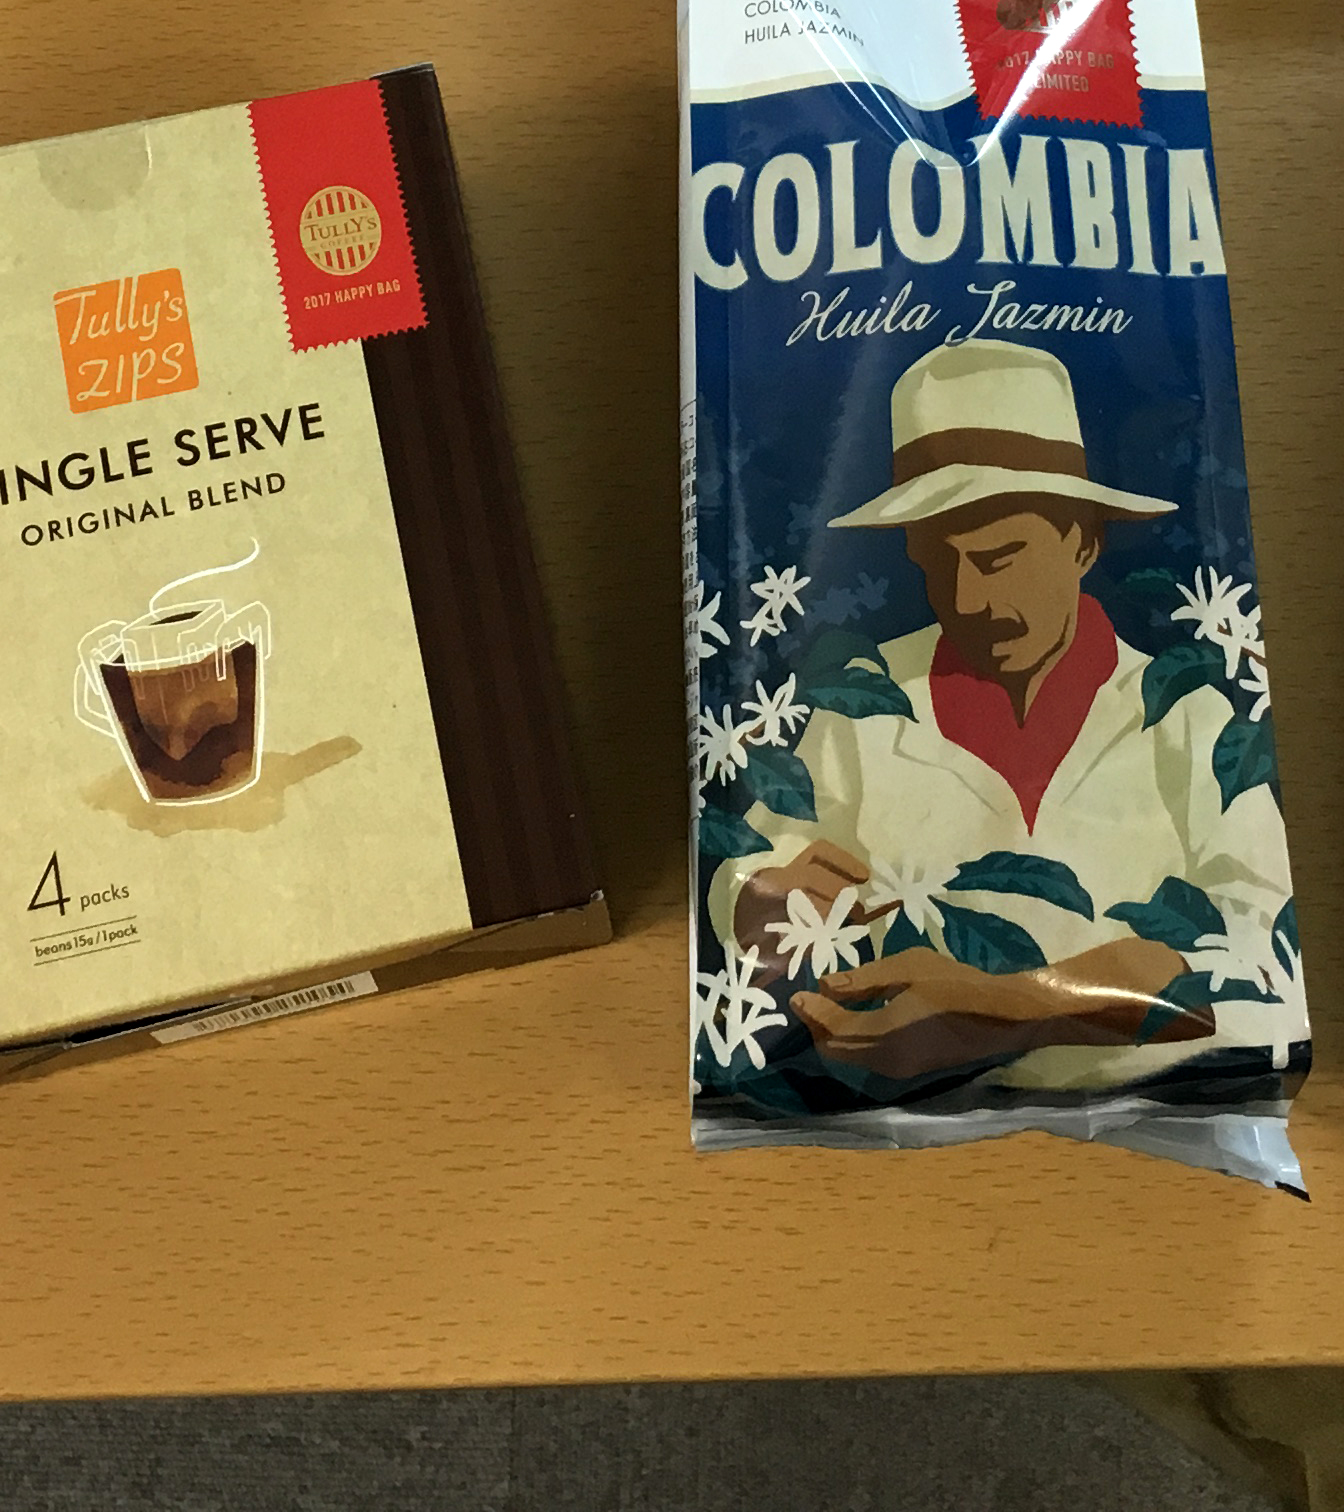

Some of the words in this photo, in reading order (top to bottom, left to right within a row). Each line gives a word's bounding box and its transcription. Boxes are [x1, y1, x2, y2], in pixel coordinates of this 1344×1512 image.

[745, 22, 791, 44] HUILA
[798, 20, 864, 46] JAZMIN
[1087, 51, 1114, 69] BAG
[304, 215, 377, 243] TULLY'S
[691, 134, 1227, 291] COLOMBIA
[53, 275, 185, 346] Tully's
[304, 292, 331, 310] 2017
[334, 284, 374, 304] HAPPY
[375, 279, 401, 295] BAG
[785, 280, 941, 346] Huila
[944, 279, 1135, 347] Jazmin
[75, 342, 185, 402] ZIPS
[173, 403, 326, 467] SERVE
[20, 496, 175, 547] ORIGINAL
[188, 472, 286, 512] BLEND
[27, 850, 71, 917] 4
[80, 884, 130, 912] packs
[35, 940, 72, 958] beans
